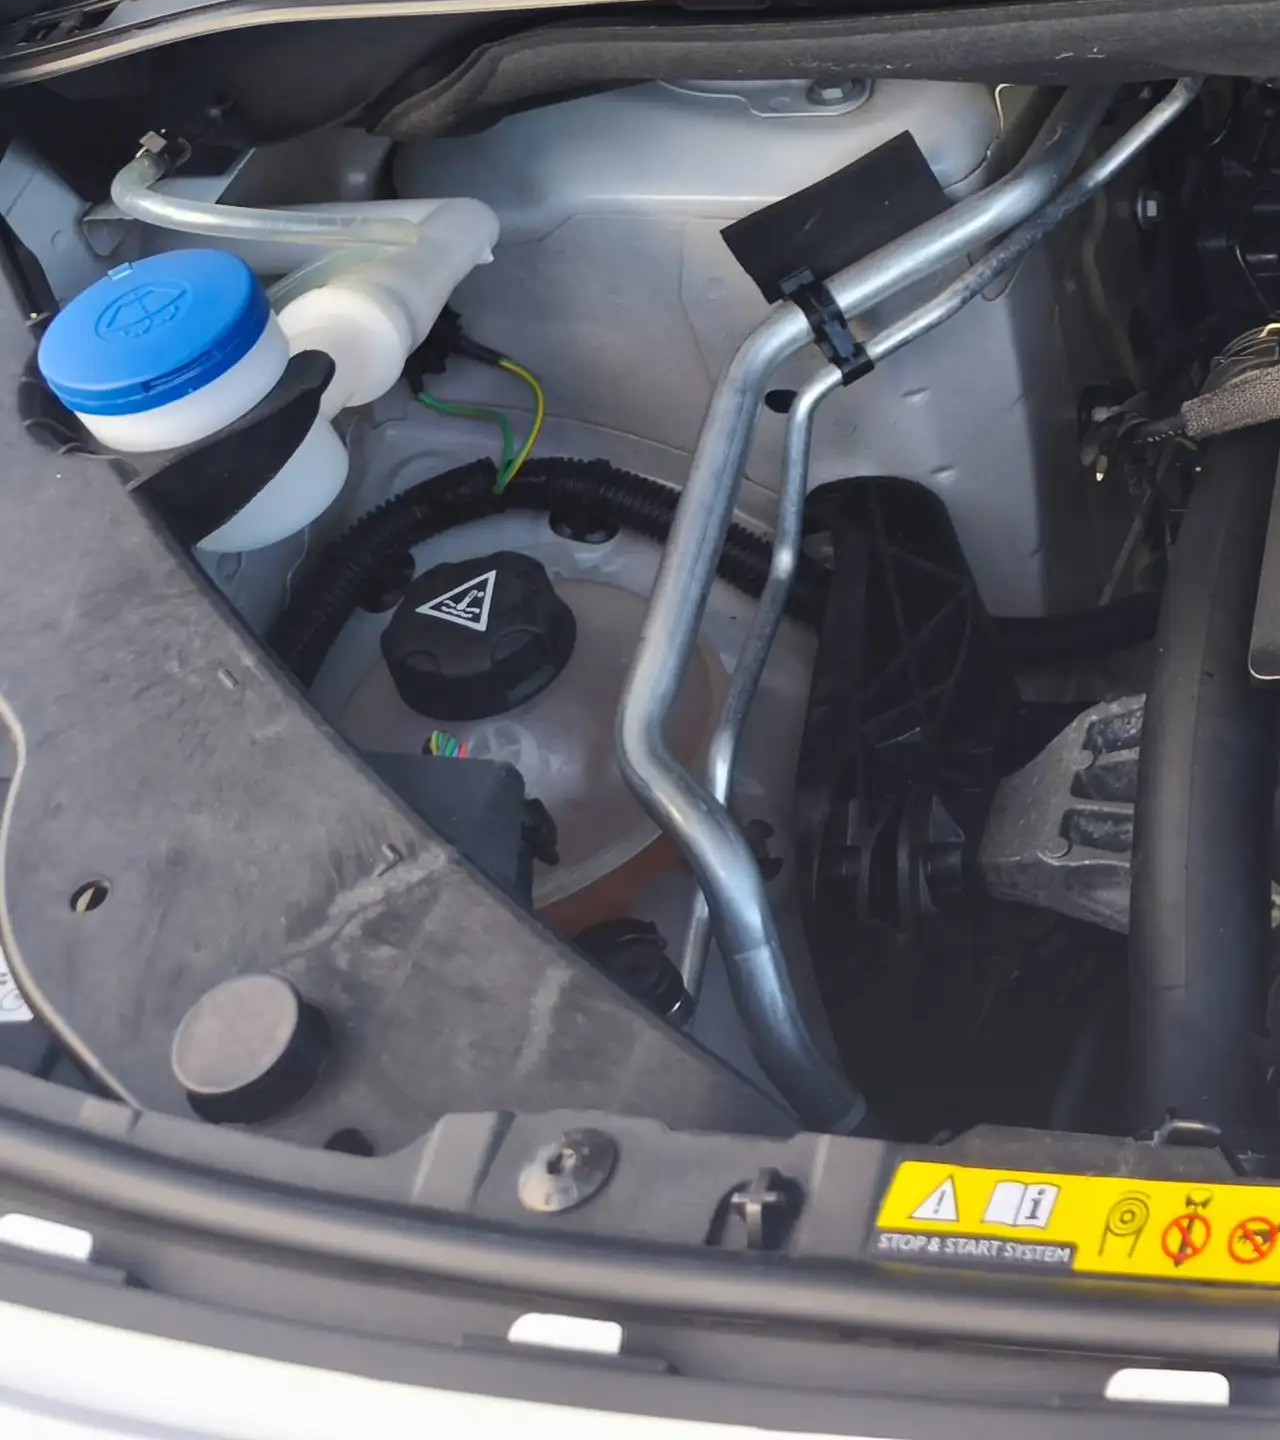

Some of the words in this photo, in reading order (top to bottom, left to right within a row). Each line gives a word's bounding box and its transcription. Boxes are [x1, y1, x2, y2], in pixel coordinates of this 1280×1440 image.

[878, 1233, 928, 1250] STOP
[927, 1237, 942, 1252] &
[944, 1237, 1003, 1257] START
[1003, 1242, 1072, 1262] SYSTEM
